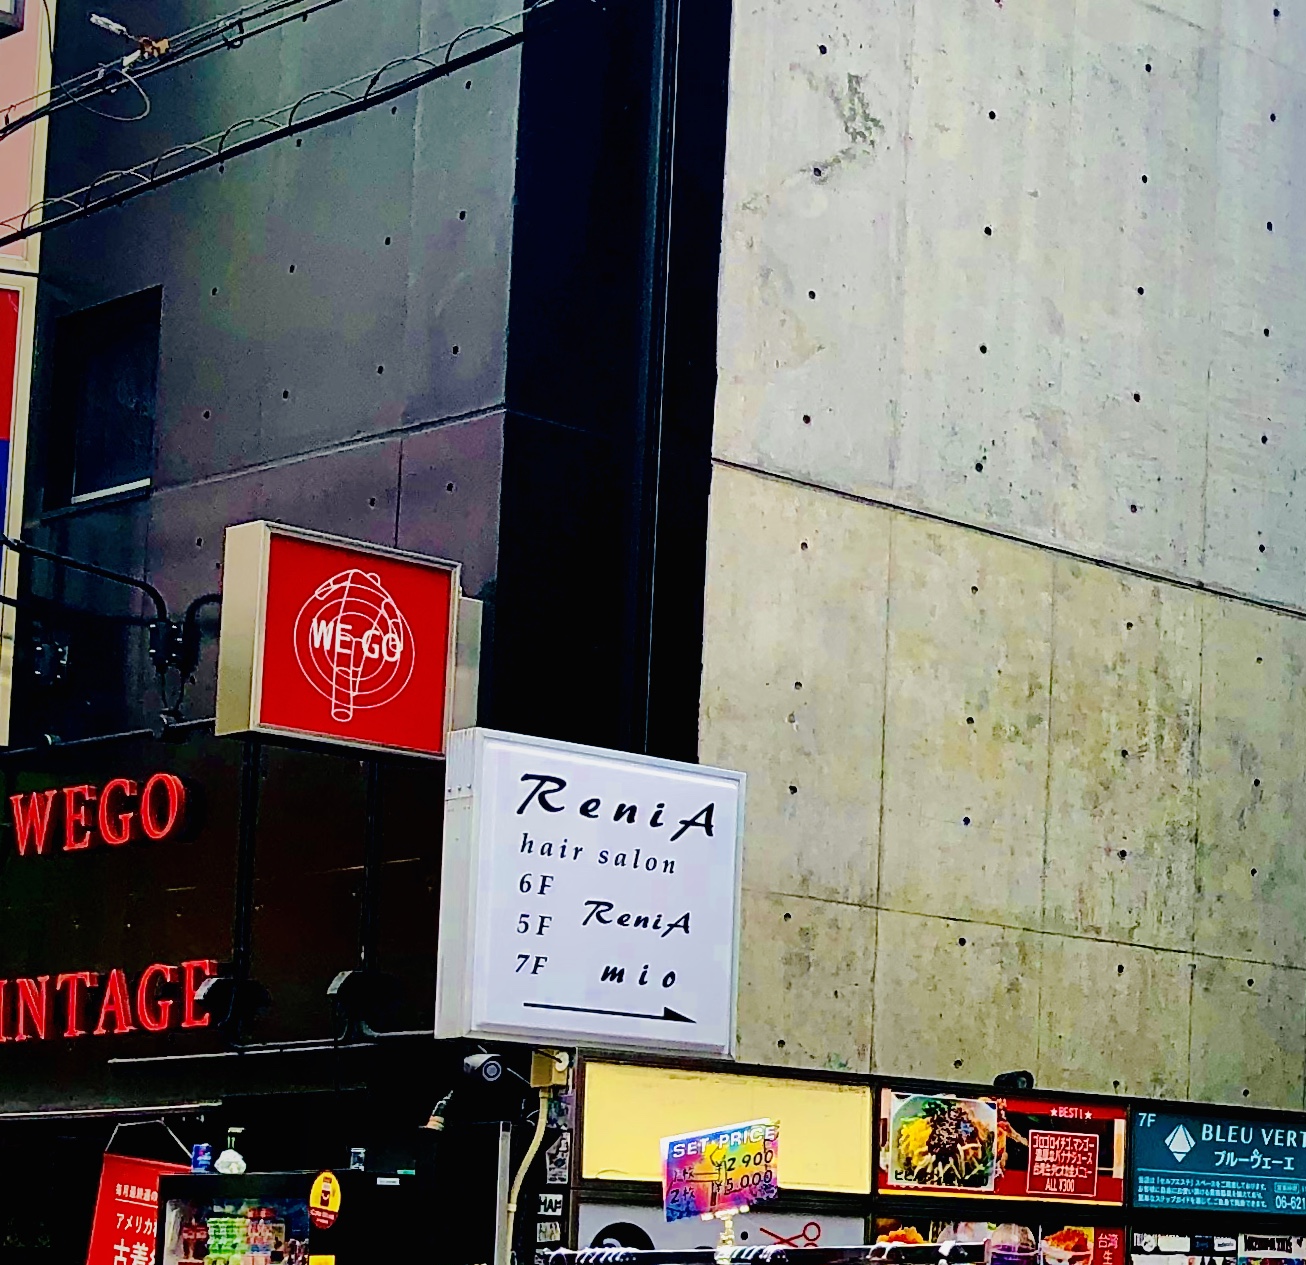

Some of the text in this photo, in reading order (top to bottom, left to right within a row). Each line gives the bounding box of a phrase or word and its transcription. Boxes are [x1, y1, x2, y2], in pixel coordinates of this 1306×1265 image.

[312, 618, 402, 663] WE GO
[11, 772, 187, 857] WEGO
[516, 772, 715, 843] ReniA
[519, 833, 677, 874] hair salon
[519, 873, 554, 897] 6F
[517, 912, 553, 936] 5F
[582, 900, 693, 937] ReniA
[516, 953, 548, 977] 7F
[1138, 1113, 1156, 1127] 7F
[1201, 1123, 1253, 1143] BLEU
